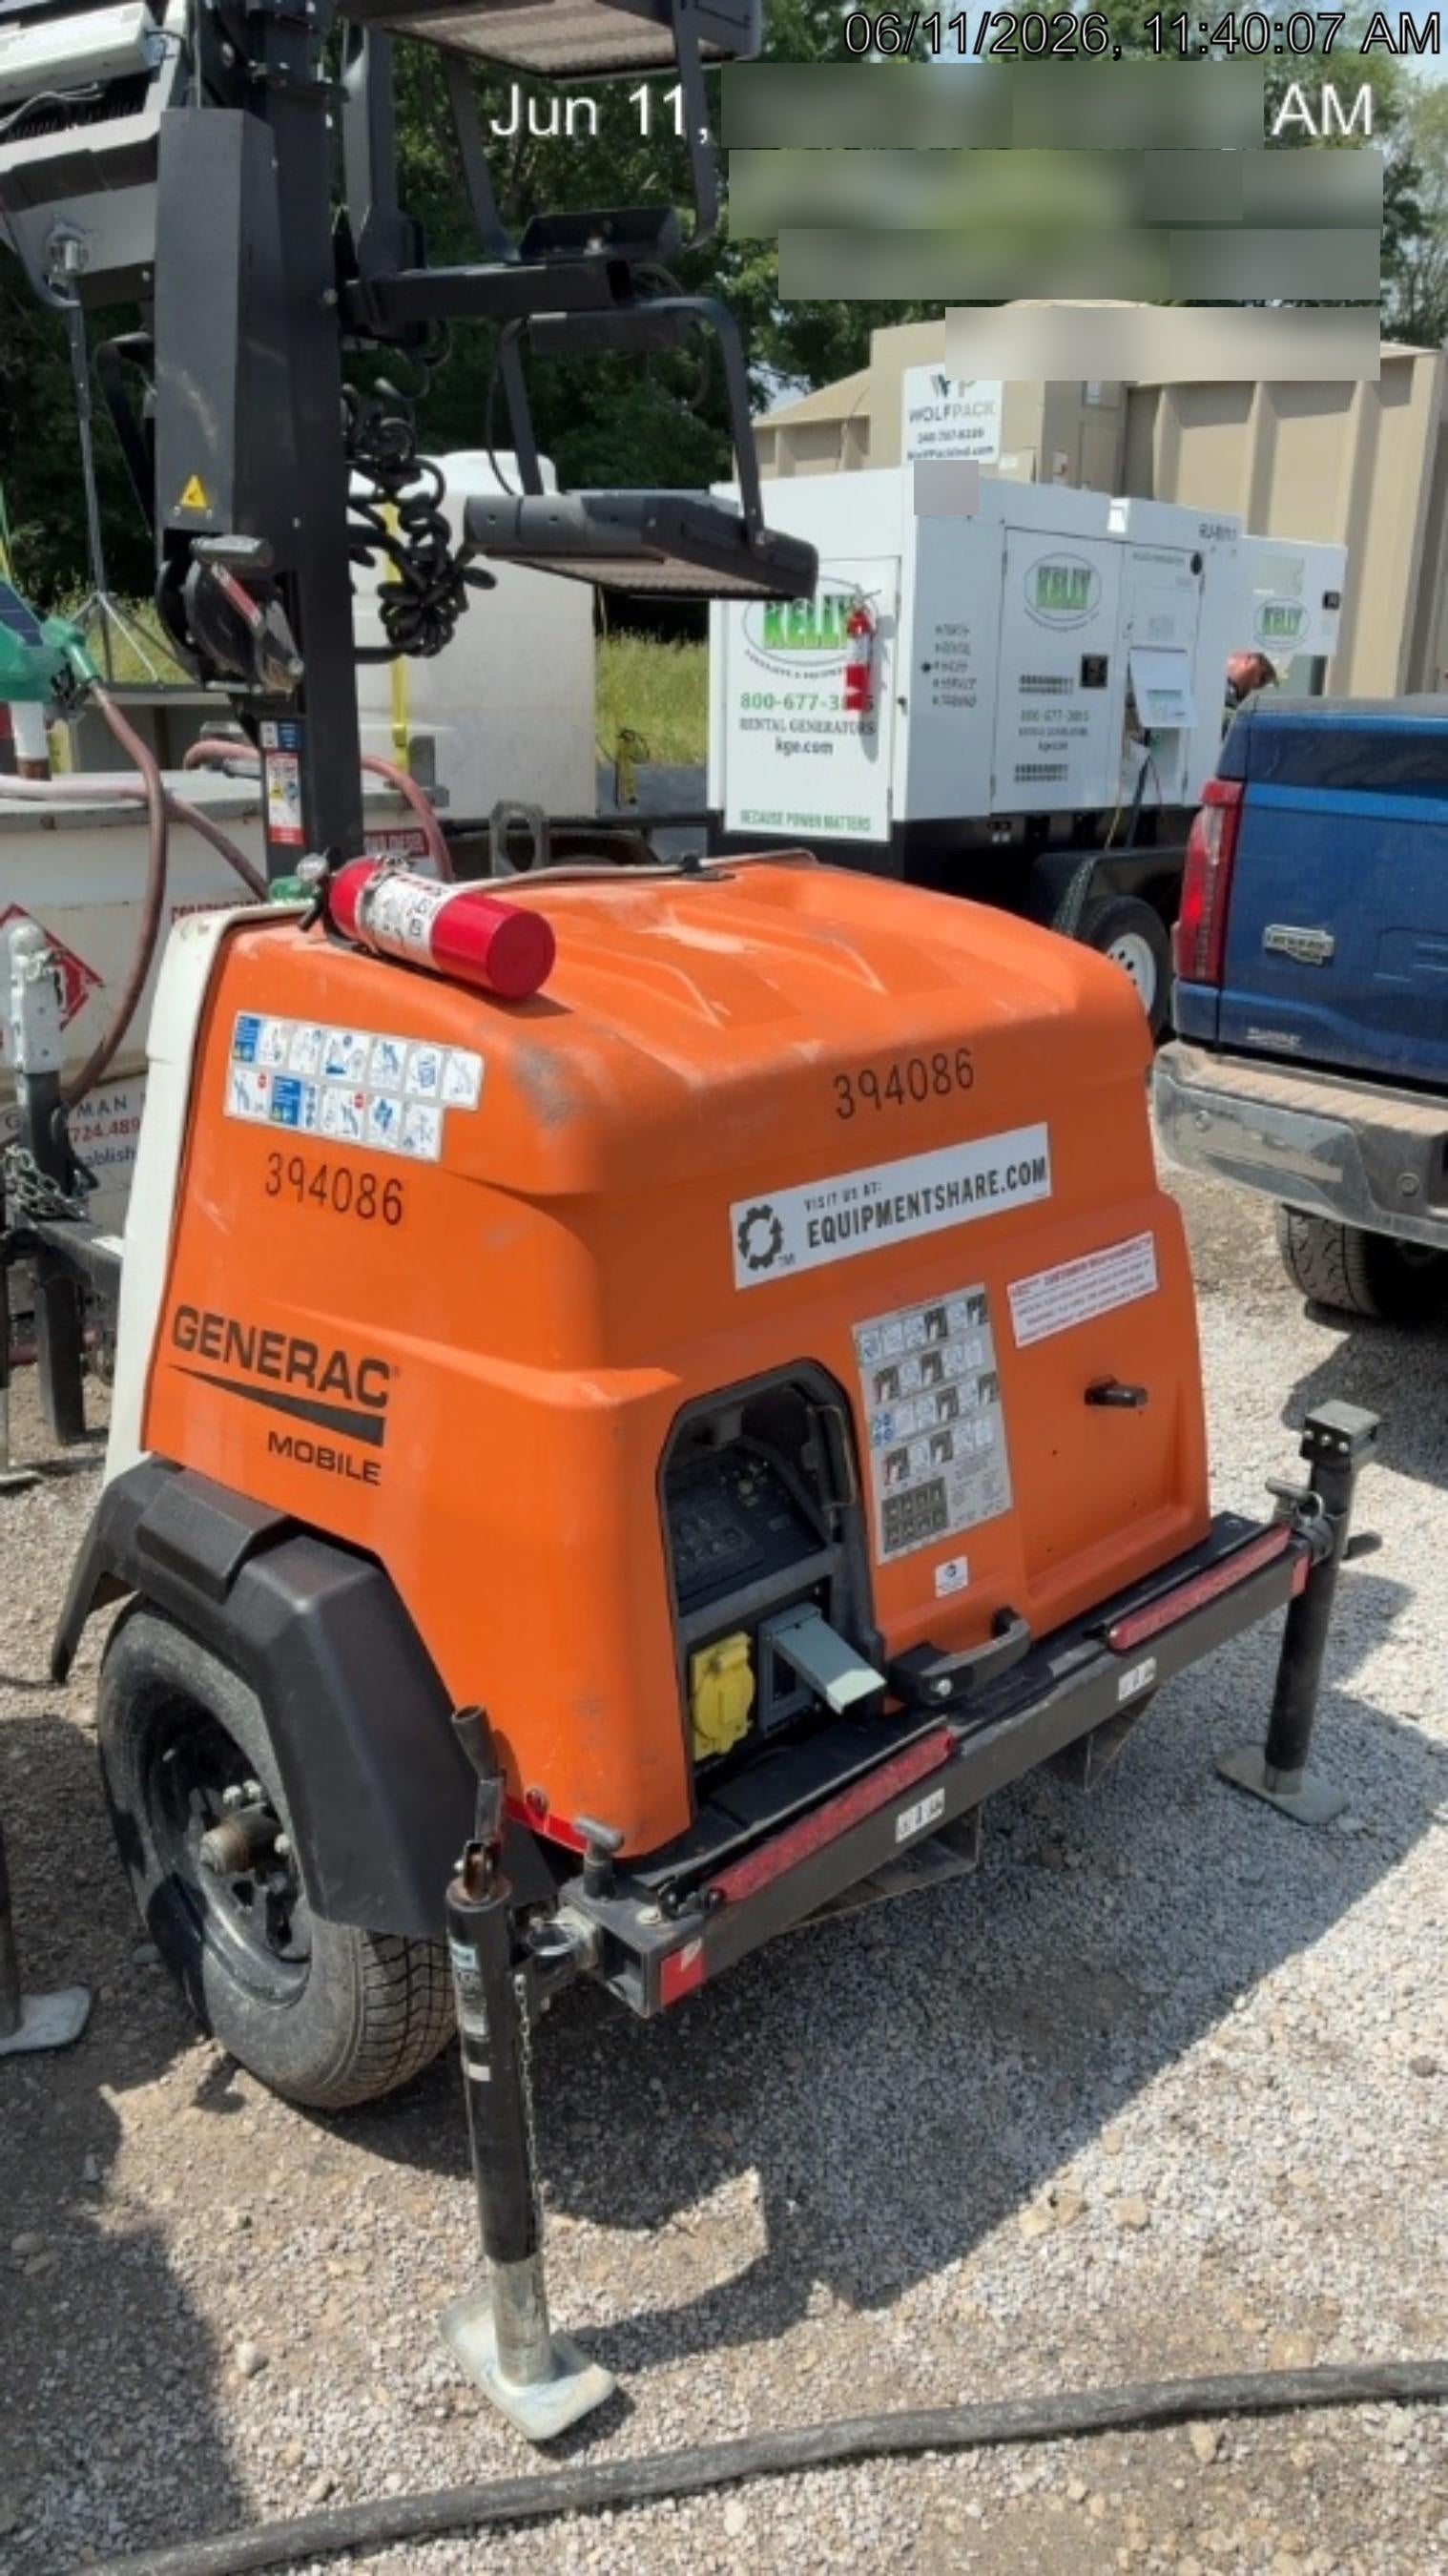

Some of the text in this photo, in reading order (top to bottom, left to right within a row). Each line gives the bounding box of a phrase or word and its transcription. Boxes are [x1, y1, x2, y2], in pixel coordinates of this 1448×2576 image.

[740, 691, 874, 713] 800-677-35
[739, 717, 877, 737] RENTAL GENERATORS
[775, 736, 834, 756] kge.com
[740, 809, 871, 832] BECAUSE POWER MATTERS
[834, 1048, 974, 1120] 394086
[264, 1152, 404, 1226] 394086
[803, 1182, 882, 1213] VISIT US AT:
[806, 1155, 1047, 1249] EQUIPMENTSHARE.COM
[172, 1304, 392, 1409] GENERAC
[267, 1430, 383, 1486] MOBILE
